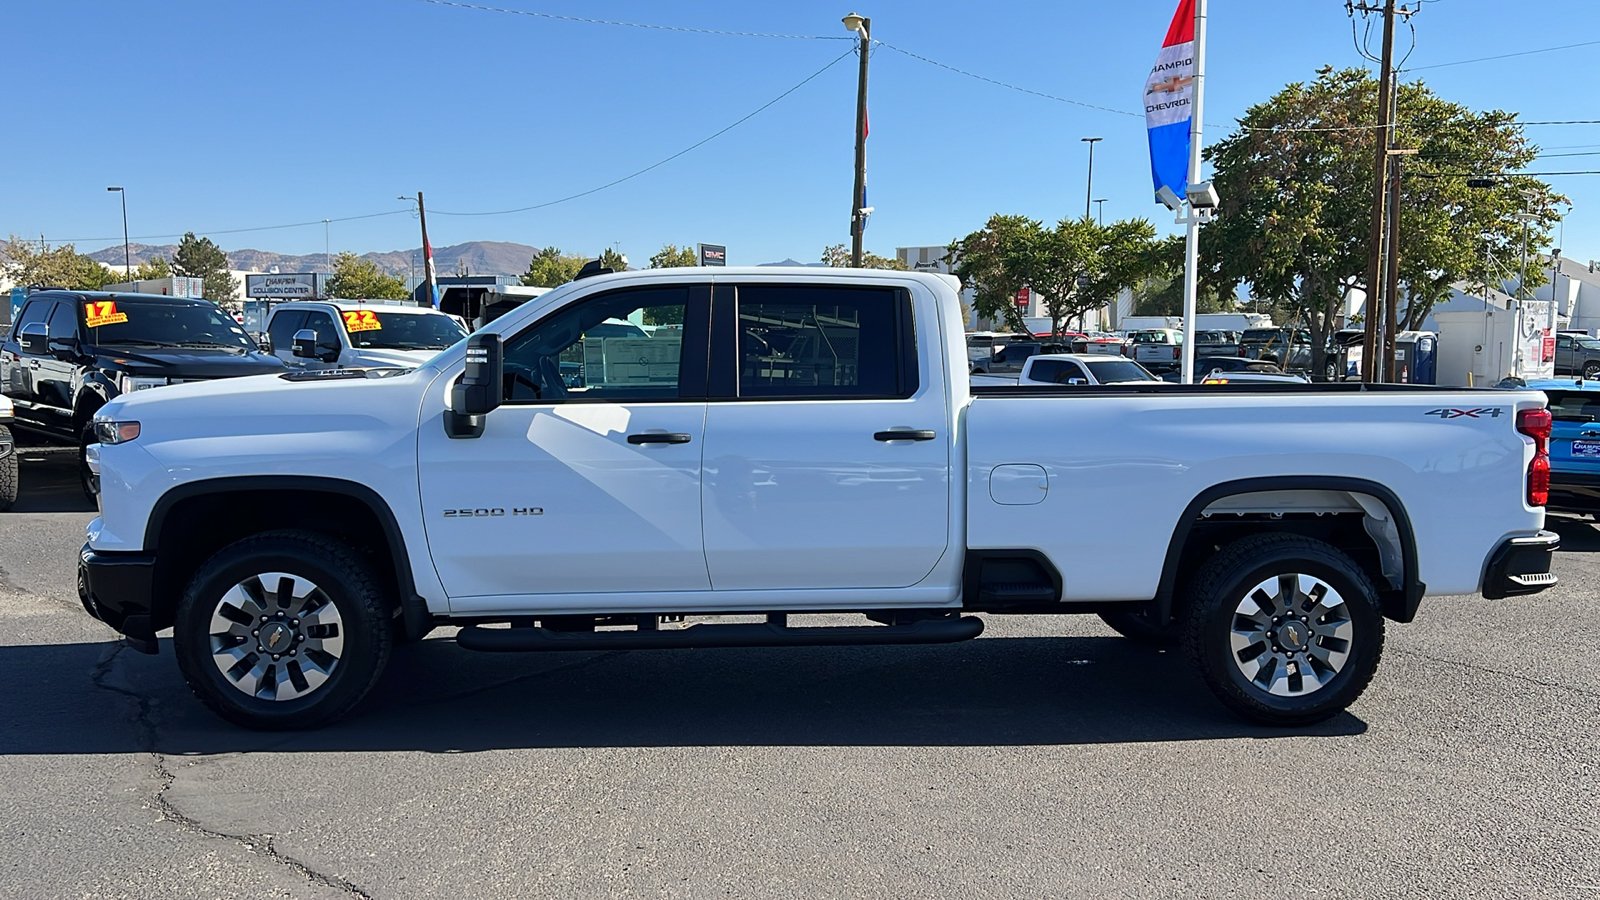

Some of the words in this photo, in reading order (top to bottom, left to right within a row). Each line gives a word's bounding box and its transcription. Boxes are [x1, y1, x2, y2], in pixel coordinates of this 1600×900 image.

[1152, 57, 1193, 72] HAMPIO
[705, 250, 724, 259] GMC
[265, 278, 296, 287] CHAMPION
[86, 301, 113, 318] 17
[344, 310, 376, 324] 22
[443, 508, 505, 518] 2500
[513, 507, 544, 516] HD
